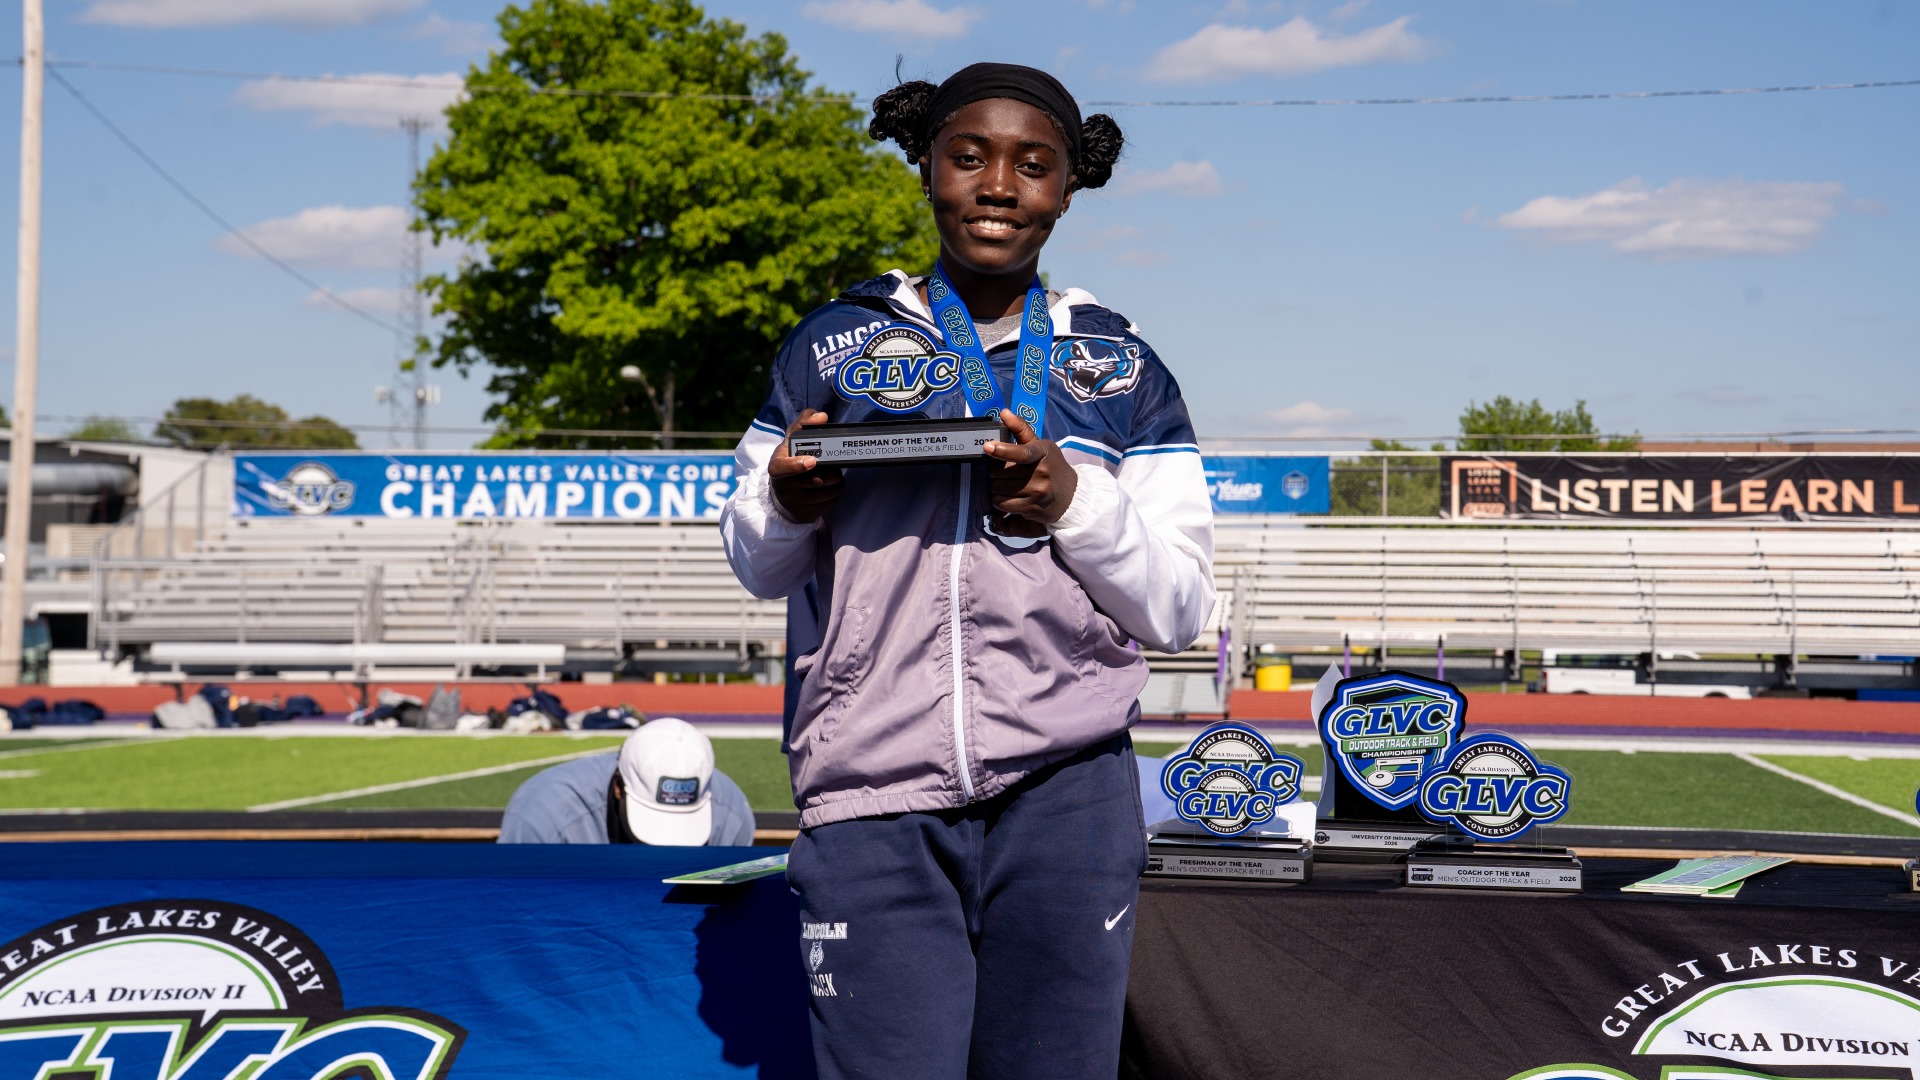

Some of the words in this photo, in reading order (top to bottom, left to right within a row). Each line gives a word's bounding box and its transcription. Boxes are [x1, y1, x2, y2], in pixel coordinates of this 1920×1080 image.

[940, 305, 974, 346] GLVC
[1028, 292, 1048, 336] GLVC
[812, 320, 890, 360] LINCO
[866, 335, 885, 354] GREAT
[909, 332, 932, 351] VALLEY
[840, 354, 960, 392] GLVC
[962, 357, 994, 402] GLVC
[1021, 344, 1044, 394] GLVC
[878, 395, 924, 408] CONFERENCE
[826, 448, 864, 457] WOMEN'S
[865, 447, 905, 455] OUTDOOR
[907, 445, 934, 453] TRACK
[842, 438, 890, 448] FRESHMAN
[891, 438, 903, 446] OF
[905, 437, 922, 445] THE
[924, 436, 948, 444] YEAR
[385, 464, 464, 482] GREAT
[476, 464, 552, 482] LAKES
[564, 464, 655, 482] VALLEY
[1531, 479, 1694, 512] LISTEN
[1711, 480, 1874, 512] LEARN
[1333, 701, 1452, 738] GLVC
[1195, 736, 1216, 755] GREAT
[1217, 732, 1241, 740] LAKES
[1244, 734, 1268, 757] VALLEY
[1349, 739, 1385, 750] OUTDOOR
[1386, 738, 1411, 749] TRACK
[1411, 737, 1418, 747] &
[1419, 736, 1439, 746] FIELD
[1362, 749, 1427, 758] CHAMPIONSHIP
[1454, 751, 1476, 770] GREAT
[1506, 749, 1533, 771] VALLEY
[1200, 774, 1216, 788] GREAT
[1235, 772, 1253, 790] VALLEY
[1180, 792, 1274, 820] GLVC
[1423, 774, 1566, 816] GLVC
[1207, 822, 1243, 832] CONFERENCE
[1466, 820, 1520, 834] CONFERENCE
[802, 922, 848, 939] LINCOLN
[0, 924, 78, 980] EAT
[96, 909, 221, 936] LAKES
[230, 916, 324, 995] VALLEY
[21, 988, 97, 1008] NCAA
[220, 984, 248, 1000] II
[808, 973, 837, 996] RACK
[1601, 959, 1706, 1038] GREAT
[1717, 944, 1857, 973] LAKES
[1684, 1030, 1772, 1053] NCAA
